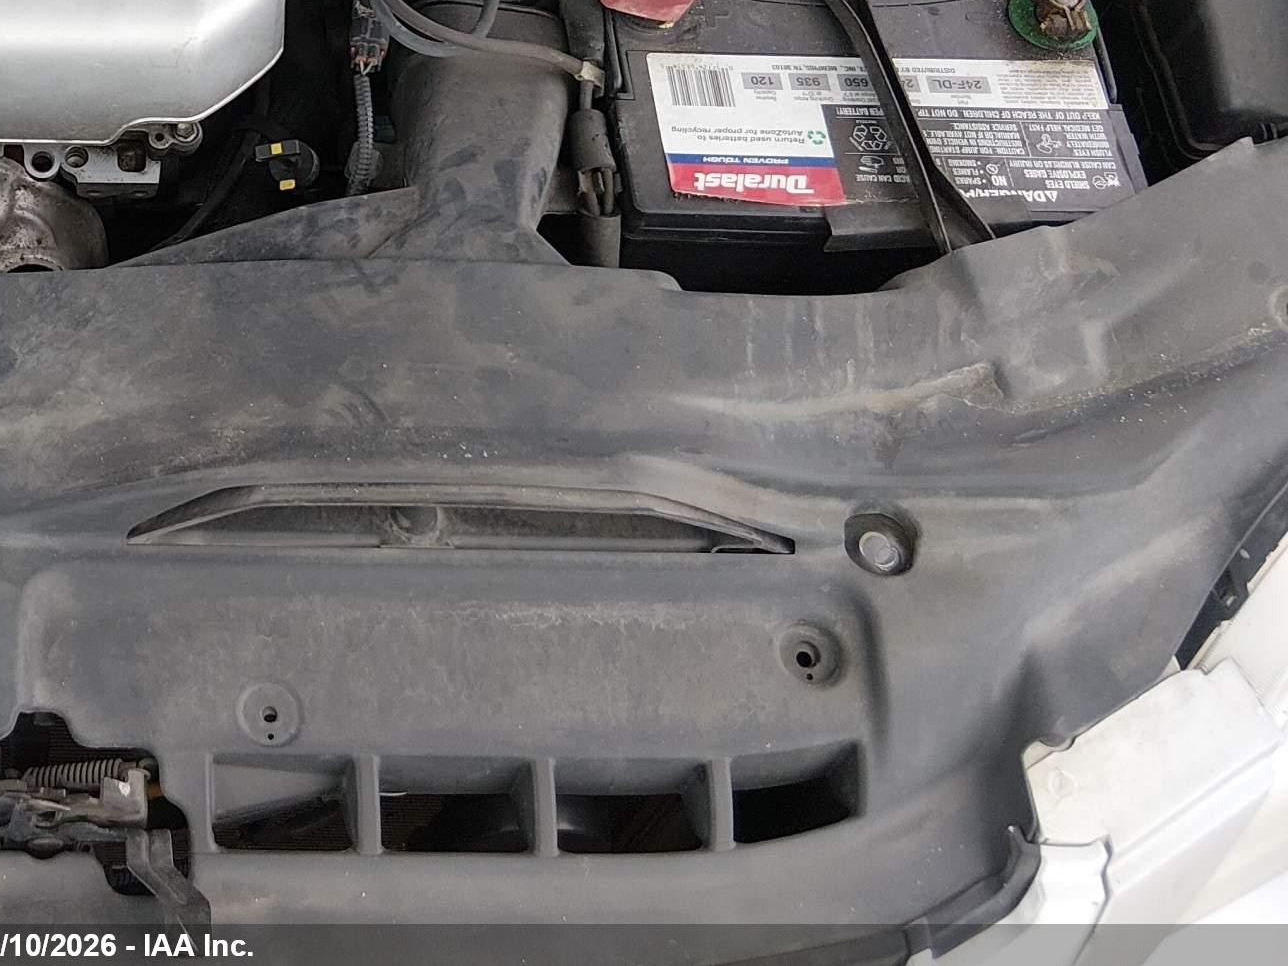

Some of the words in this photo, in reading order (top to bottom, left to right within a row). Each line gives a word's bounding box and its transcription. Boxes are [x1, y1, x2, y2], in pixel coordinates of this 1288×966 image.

[912, 66, 955, 74] DISTRIBUTED
[751, 75, 774, 85] 120
[796, 77, 820, 87] 935
[844, 77, 868, 87] 650
[932, 78, 982, 90] 24F-DL
[835, 107, 867, 115] BATTERY!
[1012, 110, 1037, 118] REACH
[1063, 111, 1079, 119] OUT
[1080, 112, 1100, 120] KEEP
[671, 126, 711, 134] recycling
[952, 168, 978, 176] FLAMES
[1024, 169, 1046, 177] GASES
[1048, 169, 1086, 178] EXPLOSIVE
[855, 174, 877, 182] CAUSE
[991, 175, 1007, 186] NO
[692, 172, 814, 194] Duralast
[1045, 179, 1063, 188] EYES
[1065, 180, 1090, 189] SHIELD
